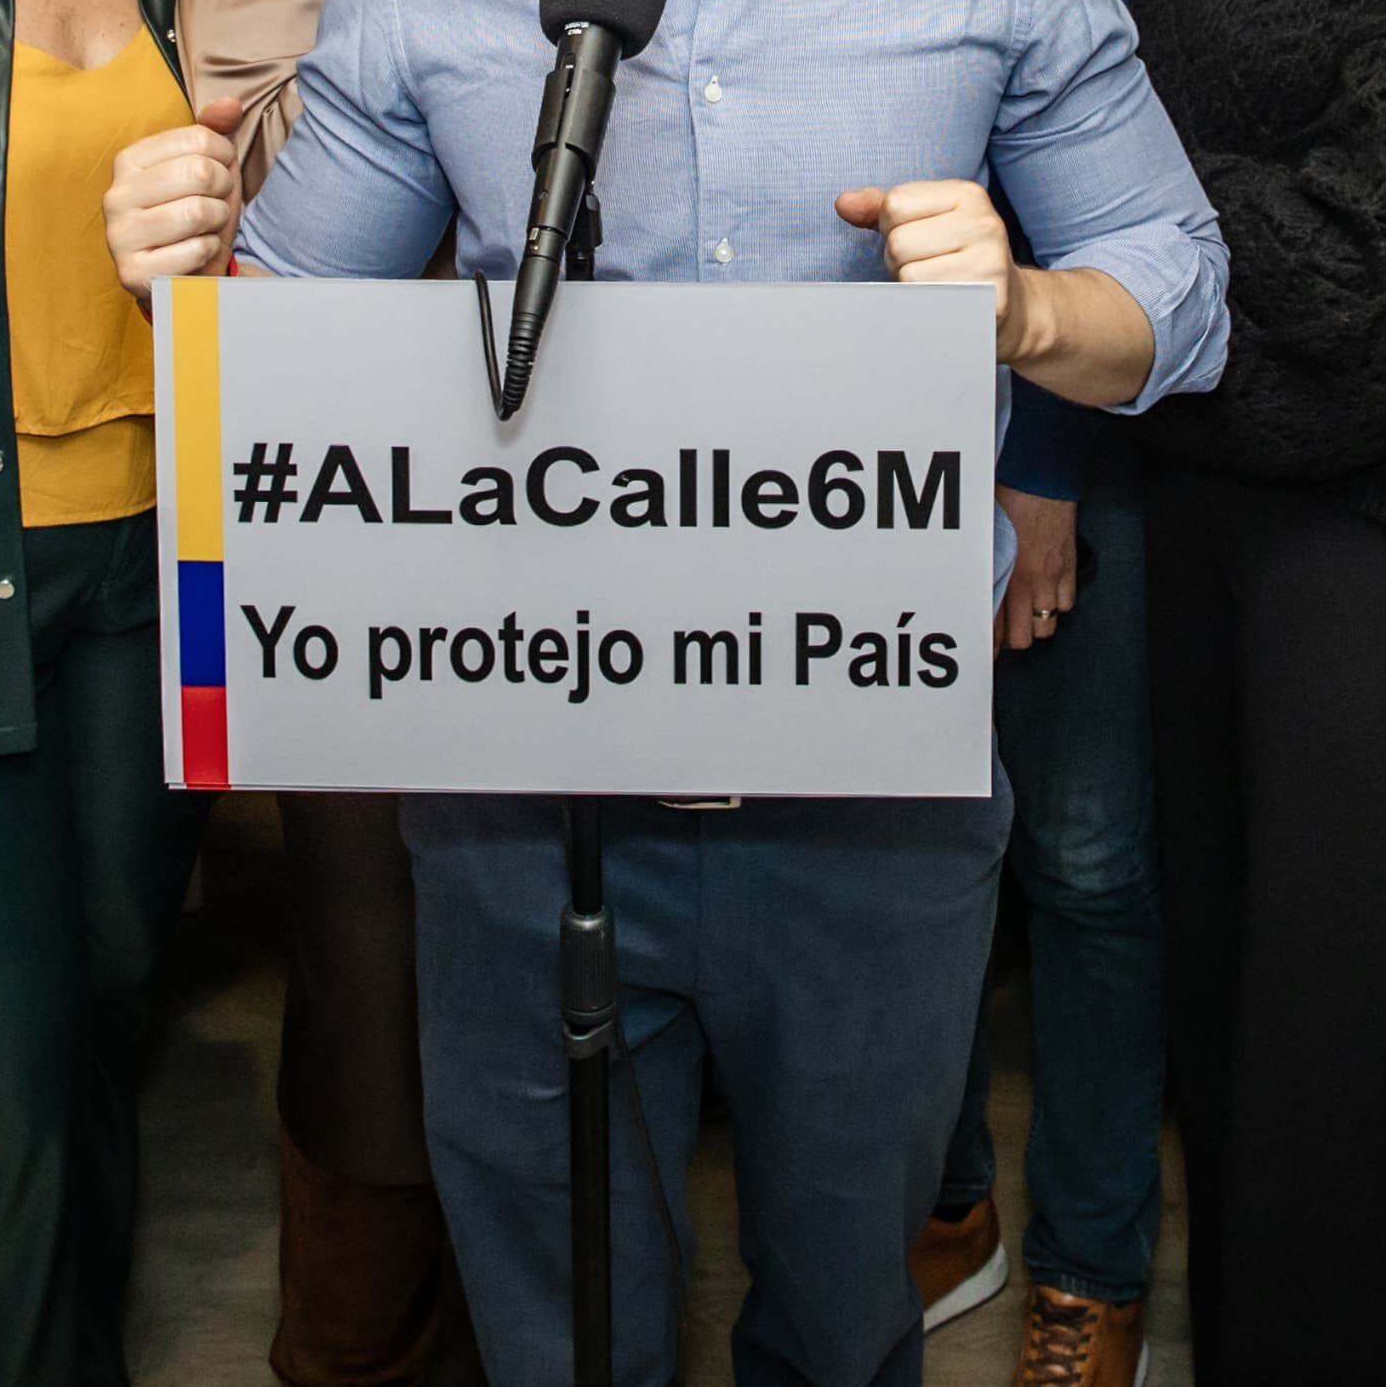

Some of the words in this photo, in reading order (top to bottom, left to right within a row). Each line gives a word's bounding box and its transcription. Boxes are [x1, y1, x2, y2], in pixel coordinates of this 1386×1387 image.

[233, 442, 961, 530] #ALaCalle6M
[240, 604, 339, 681] Yo
[368, 610, 645, 704] protejo
[673, 611, 762, 686] mi
[795, 610, 960, 689] País
